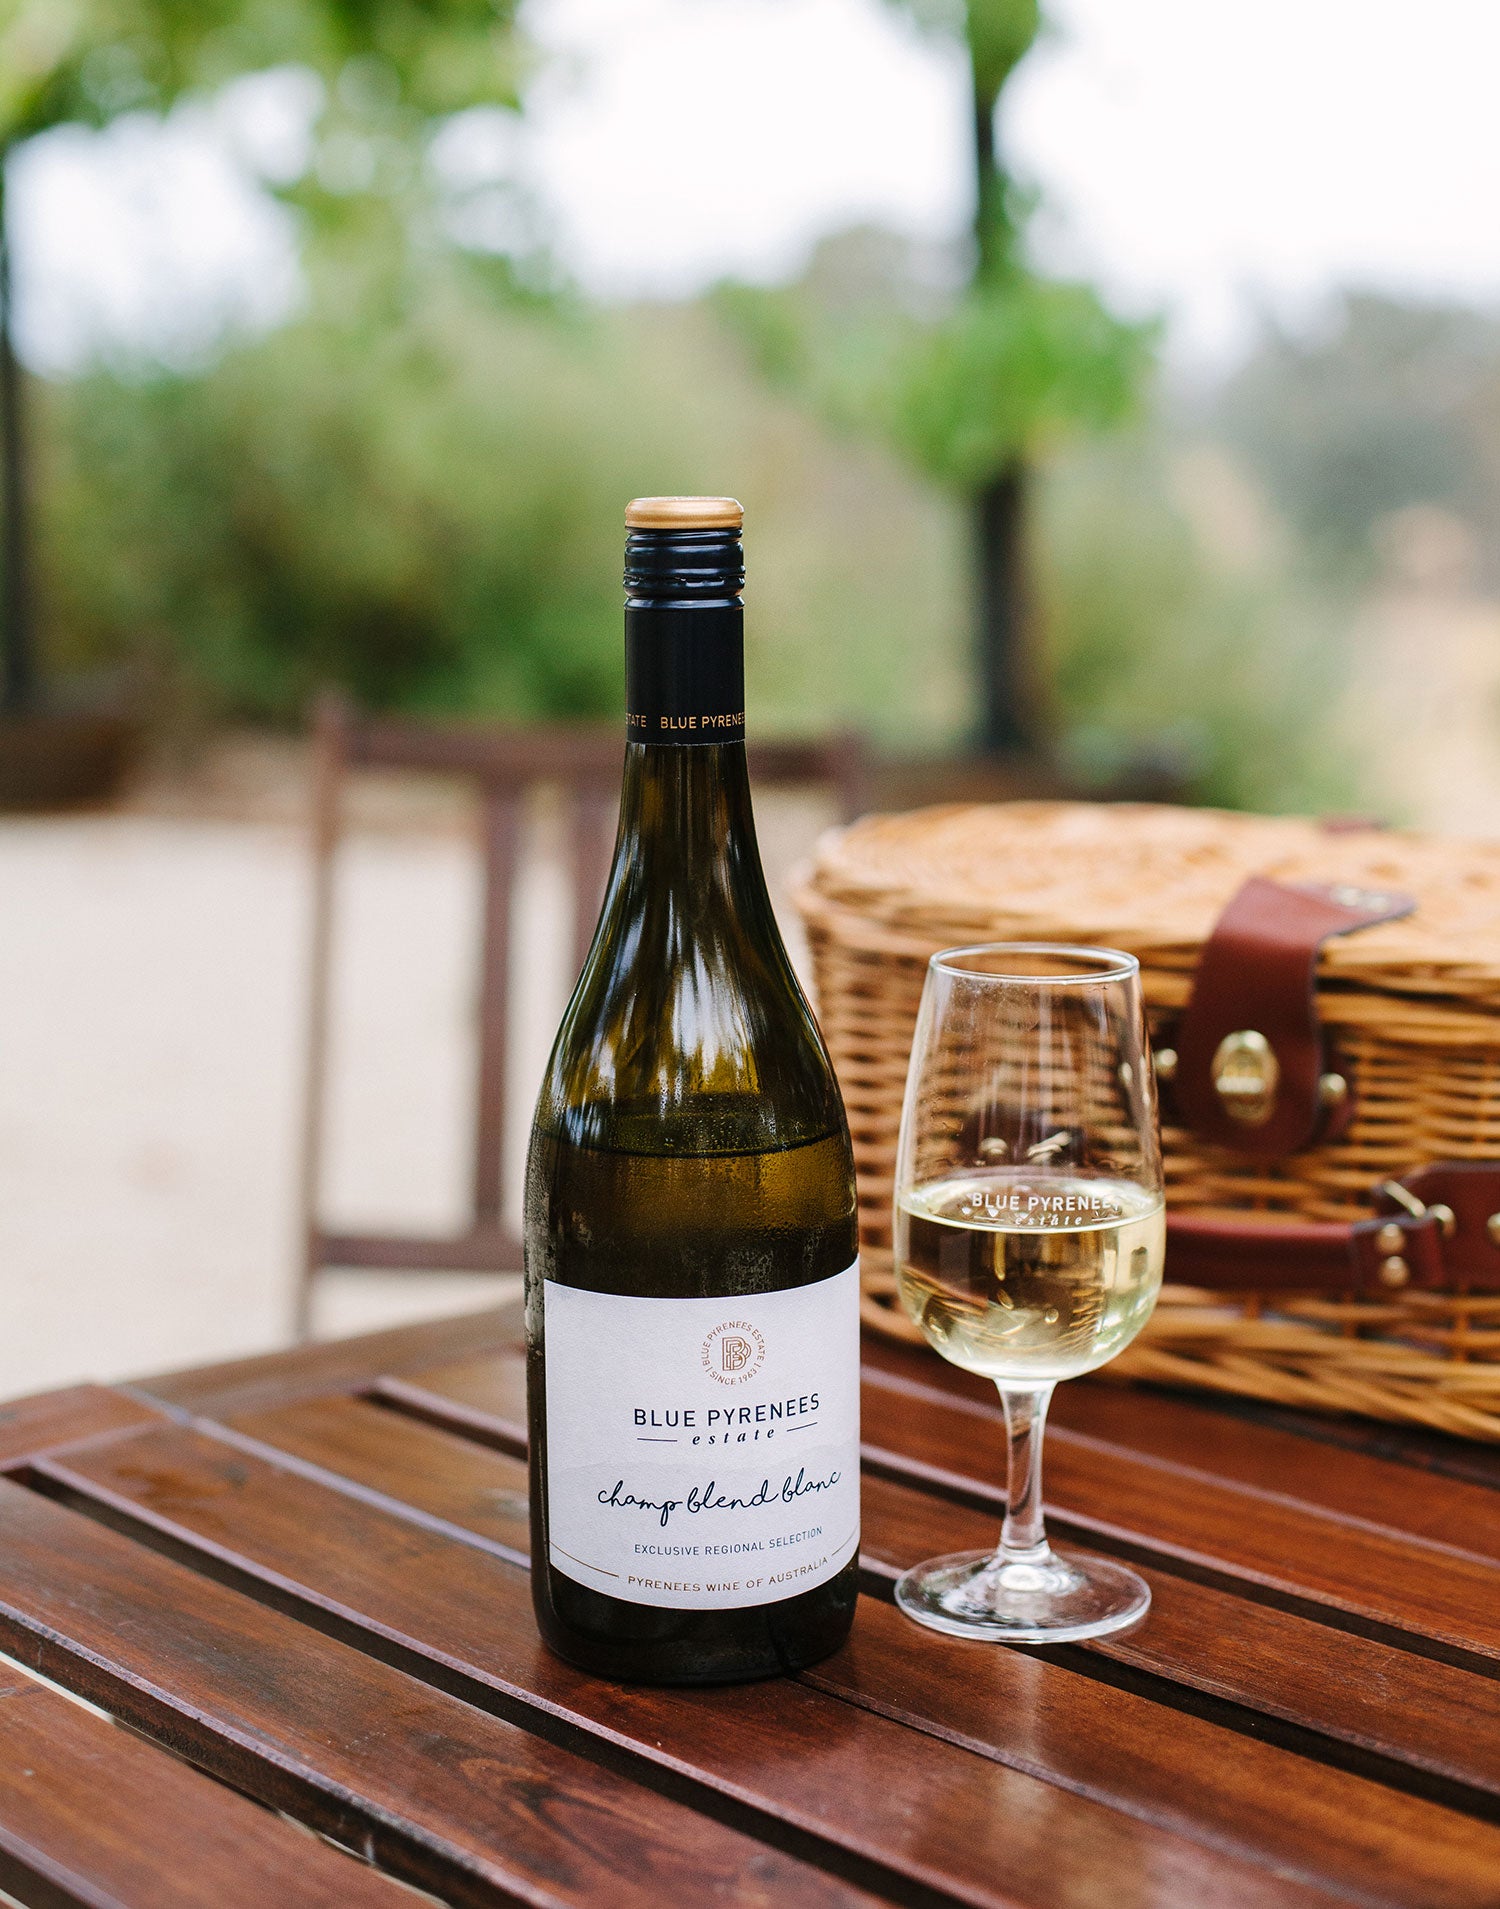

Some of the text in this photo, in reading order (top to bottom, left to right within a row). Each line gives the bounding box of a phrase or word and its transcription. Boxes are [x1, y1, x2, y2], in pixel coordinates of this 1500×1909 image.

[660, 716, 697, 729] BLUE
[972, 1192, 1119, 1212] BLUE PYRENEE
[1015, 1214, 1082, 1226] estate
[701, 1321, 766, 1366] BLUE PYRENEES ESTATE
[709, 1368, 758, 1385] SINCE 1963
[634, 1393, 820, 1427] BLUE PYRENEES
[692, 1428, 775, 1445] estate
[598, 1467, 841, 1527] champ blend blanc
[634, 1526, 823, 1556] EXCLUSIVE REGIONAL SELECTION
[627, 1556, 828, 1592] PYRENEES WINE OF AUSTRALIA
